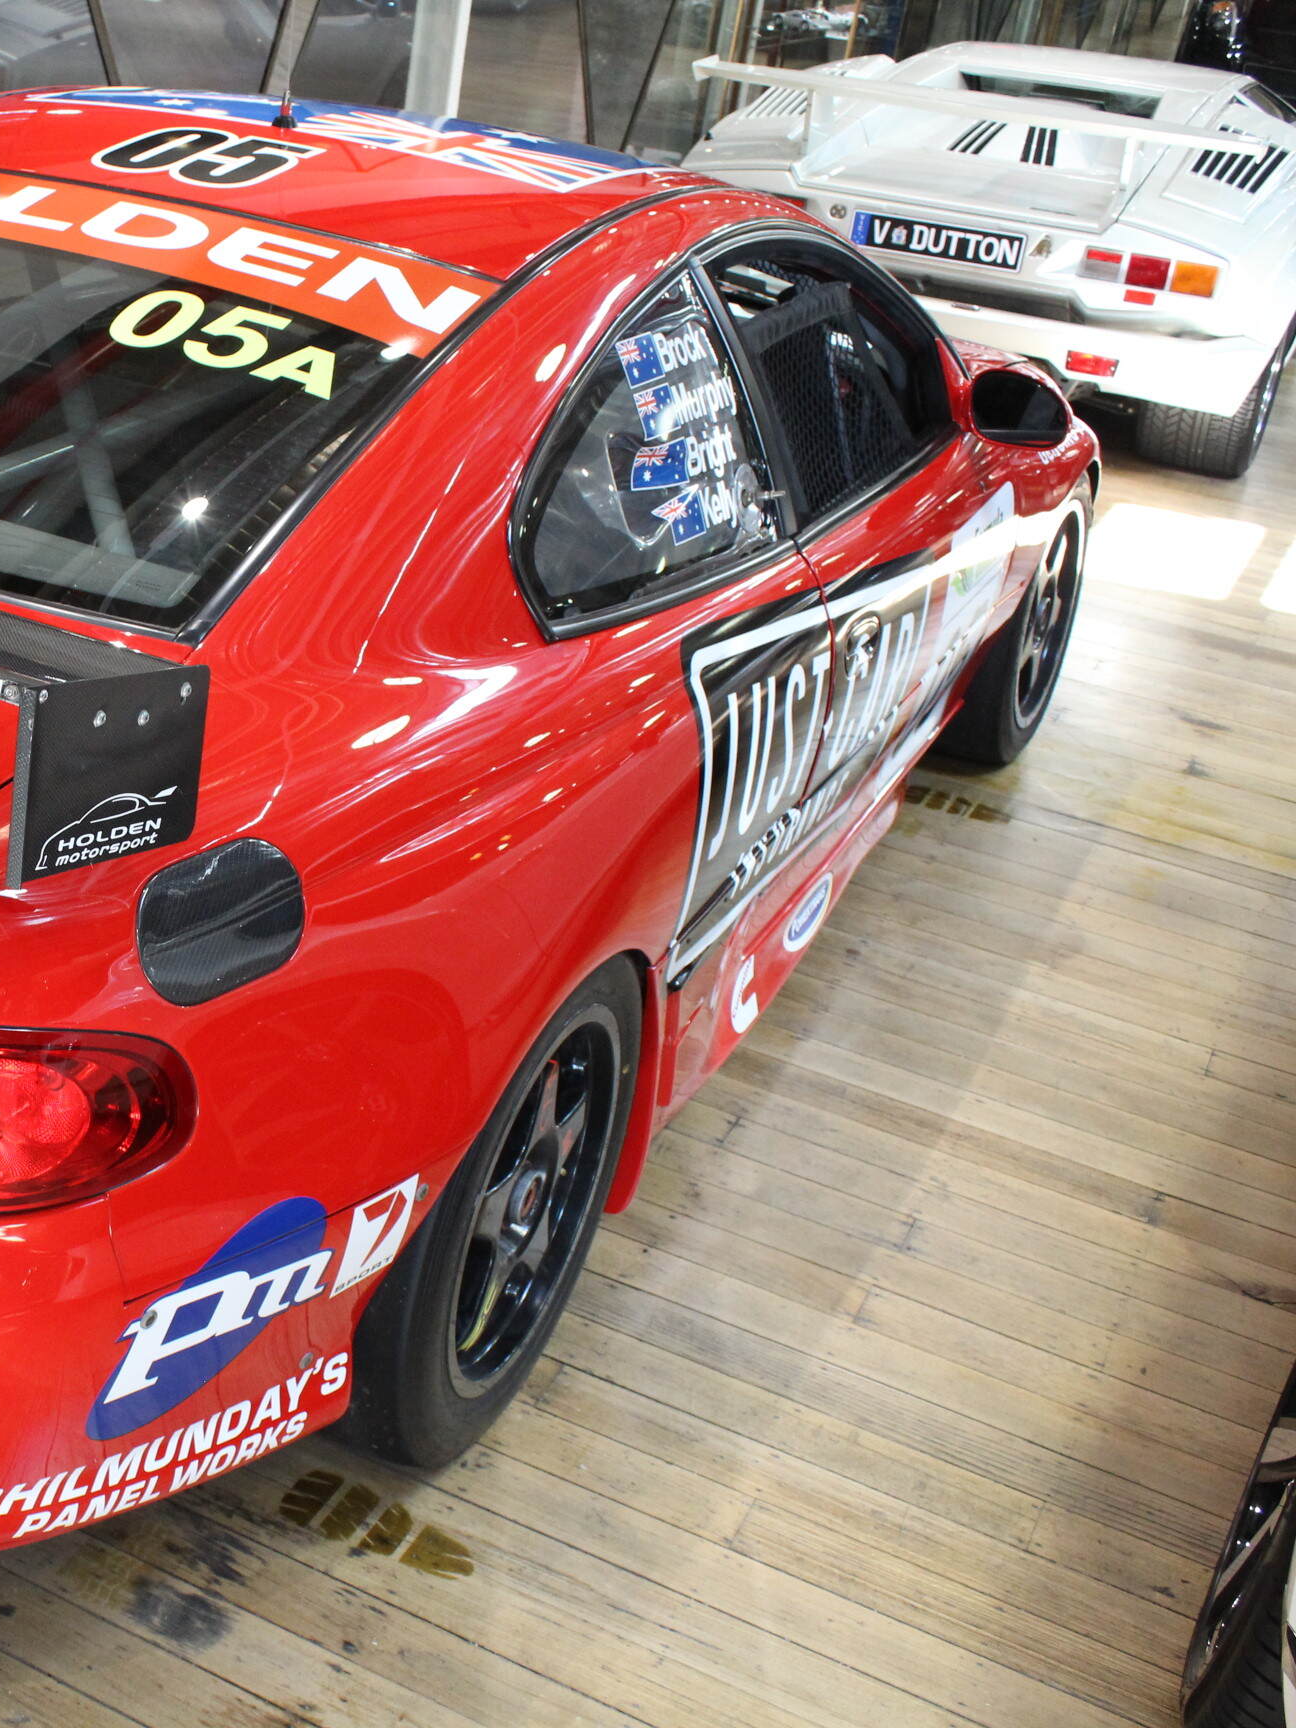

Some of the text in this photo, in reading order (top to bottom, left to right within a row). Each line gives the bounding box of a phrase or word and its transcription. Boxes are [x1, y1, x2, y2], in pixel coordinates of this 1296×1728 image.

[91, 127, 327, 188] 05
[873, 218, 892, 245] V
[908, 223, 1020, 267] DUTTON
[109, 290, 336, 400] 05A
[655, 321, 707, 373] Brock
[671, 371, 738, 425] Murphy
[688, 423, 737, 479] Bright
[698, 482, 738, 529] Kelly
[707, 650, 832, 862] JUST
[54, 831, 159, 868] motorsport
[56, 817, 163, 853] HOLDEN
[360, 1189, 409, 1269] 7
[333, 1254, 394, 1294] SPORT
[11, 1410, 309, 1540] PANEL WORKS
